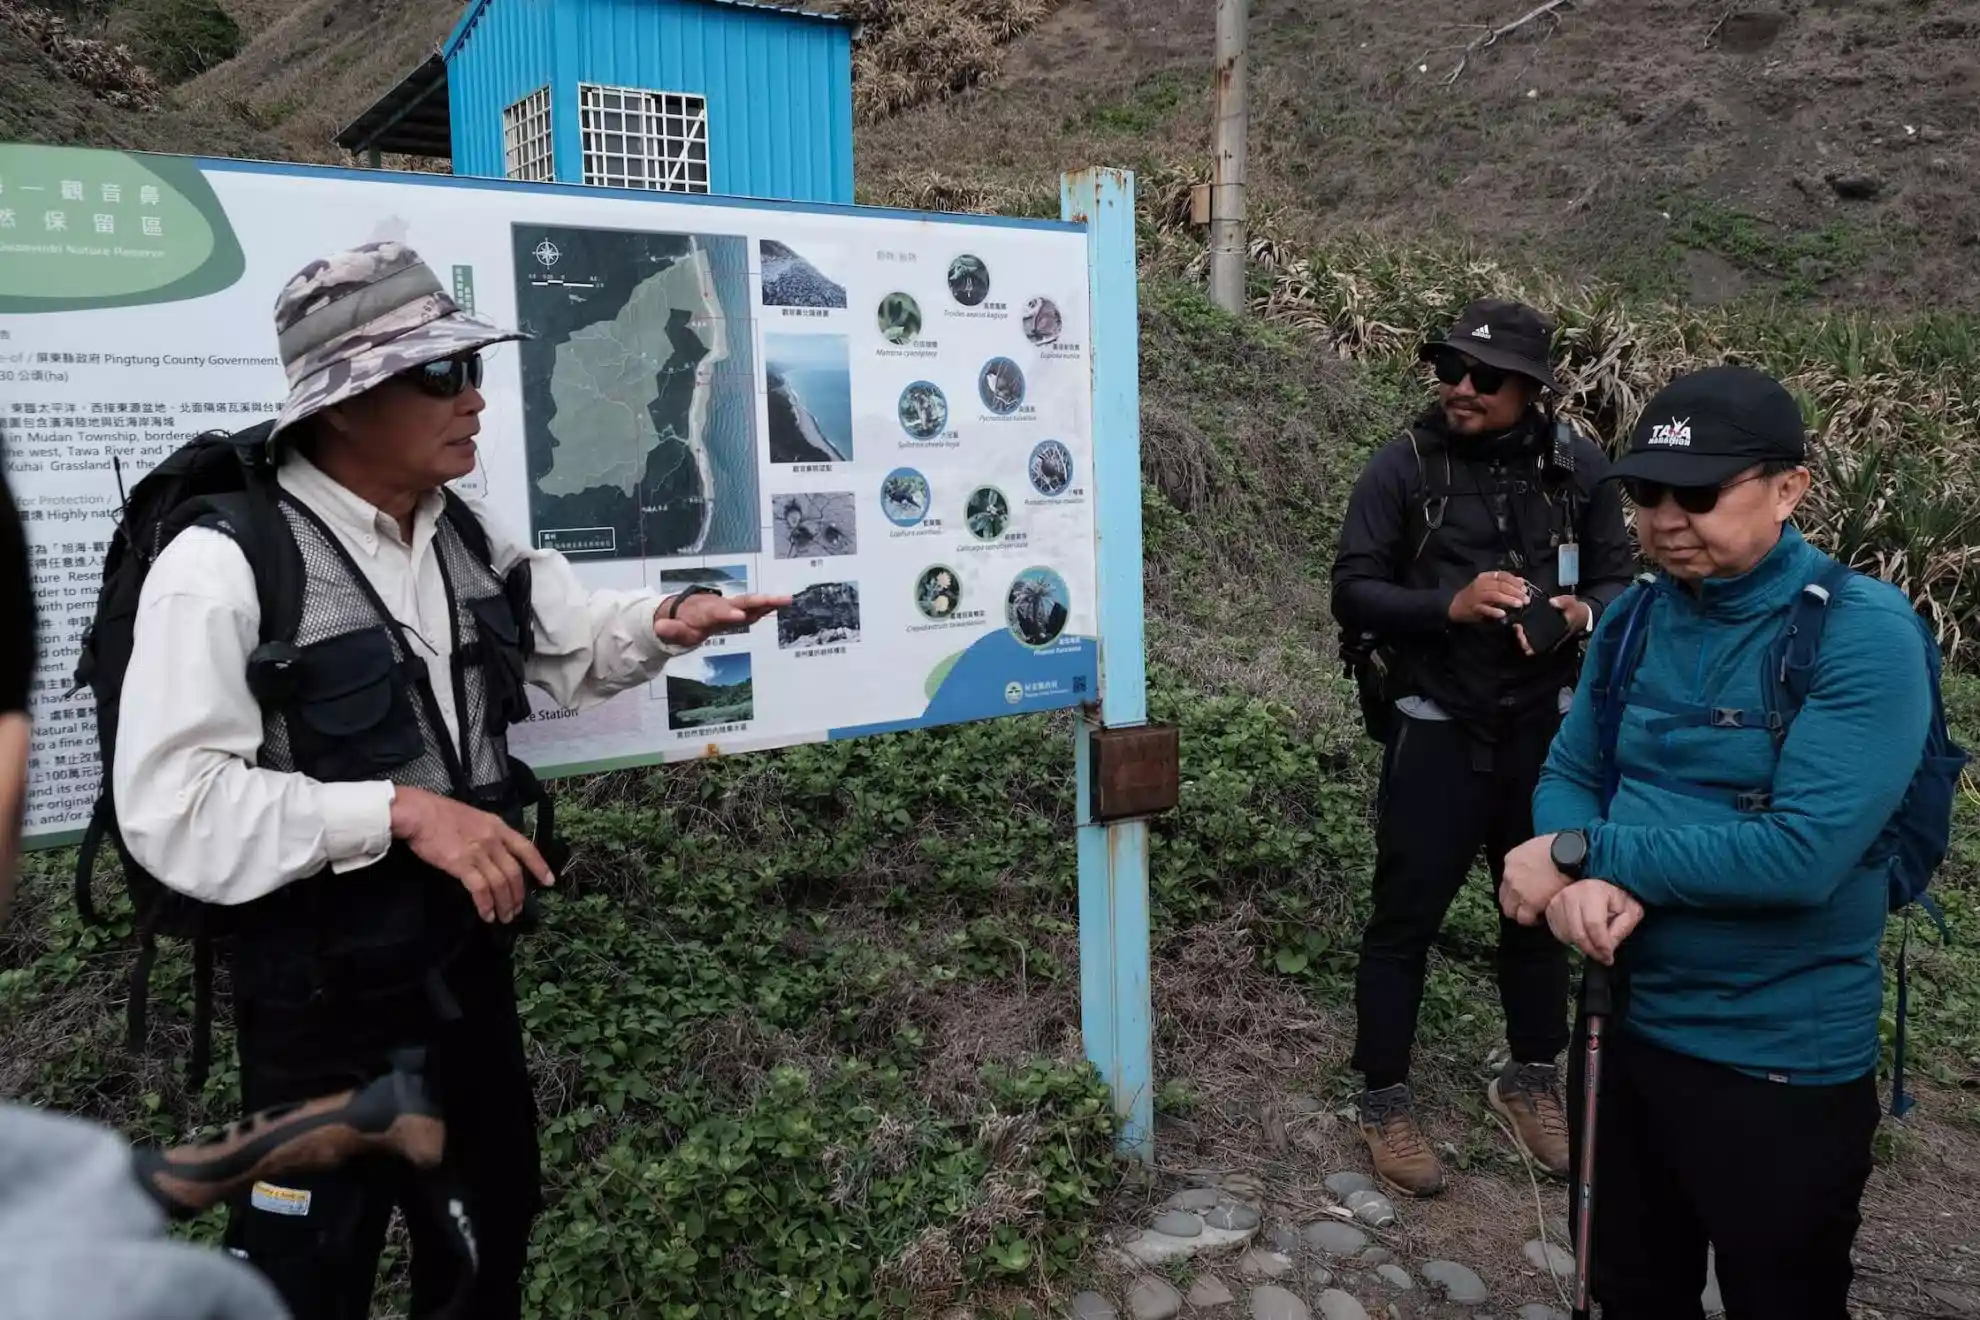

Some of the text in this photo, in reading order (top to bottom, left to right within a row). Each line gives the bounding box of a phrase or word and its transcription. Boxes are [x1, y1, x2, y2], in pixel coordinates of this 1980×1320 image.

[104, 353, 160, 367] Pingtung
[162, 354, 206, 368] County
[208, 355, 280, 366] Government
[28, 432, 73, 443] Mudan
[67, 446, 100, 456] Tawa
[105, 445, 135, 456] River
[141, 444, 163, 455] and
[51, 460, 111, 471] Grassland
[137, 460, 156, 469] the
[48, 508, 88, 522] Highly
[64, 588, 77, 597] to
[538, 707, 580, 721] Station
[31, 723, 78, 737] Natural
[60, 737, 83, 749] fine
[56, 783, 72, 794] its
[40, 811, 82, 825] and/or
